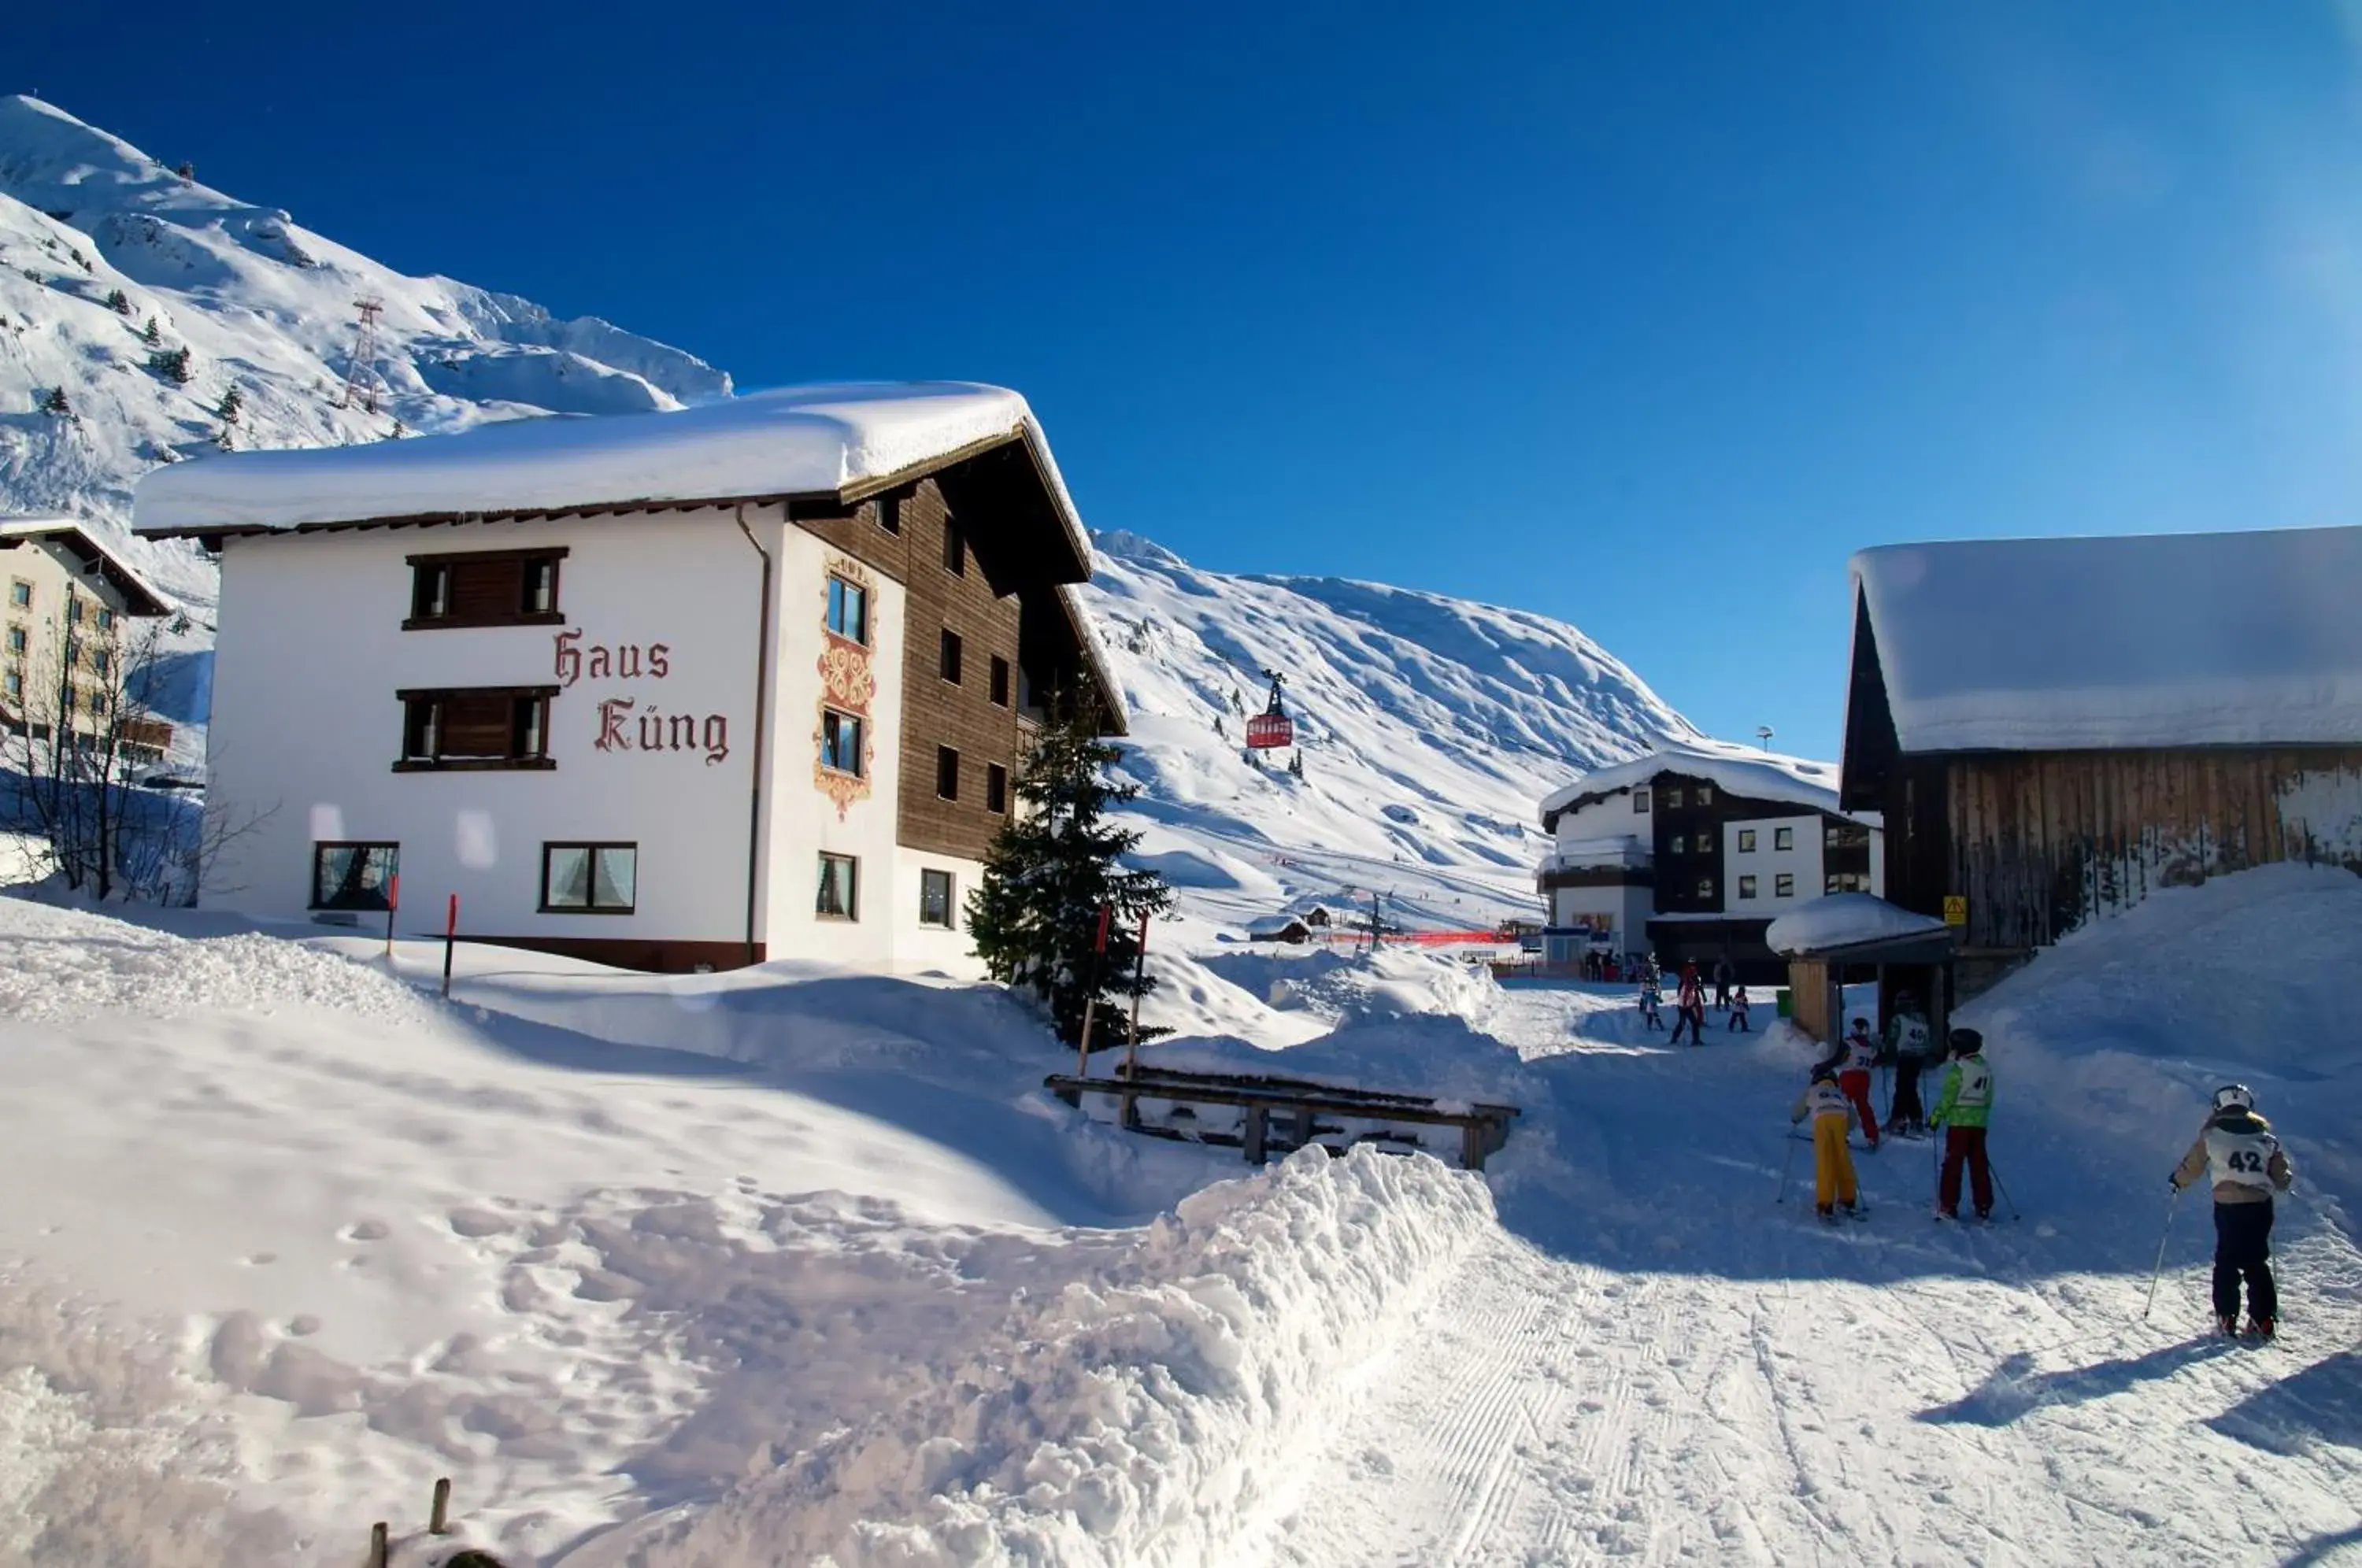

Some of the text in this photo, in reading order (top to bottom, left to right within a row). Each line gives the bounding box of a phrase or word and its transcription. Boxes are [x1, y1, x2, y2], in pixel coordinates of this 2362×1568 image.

[553, 627, 669, 686] Haus
[594, 697, 729, 767] Küng
[2228, 1151, 2263, 1173] 42
